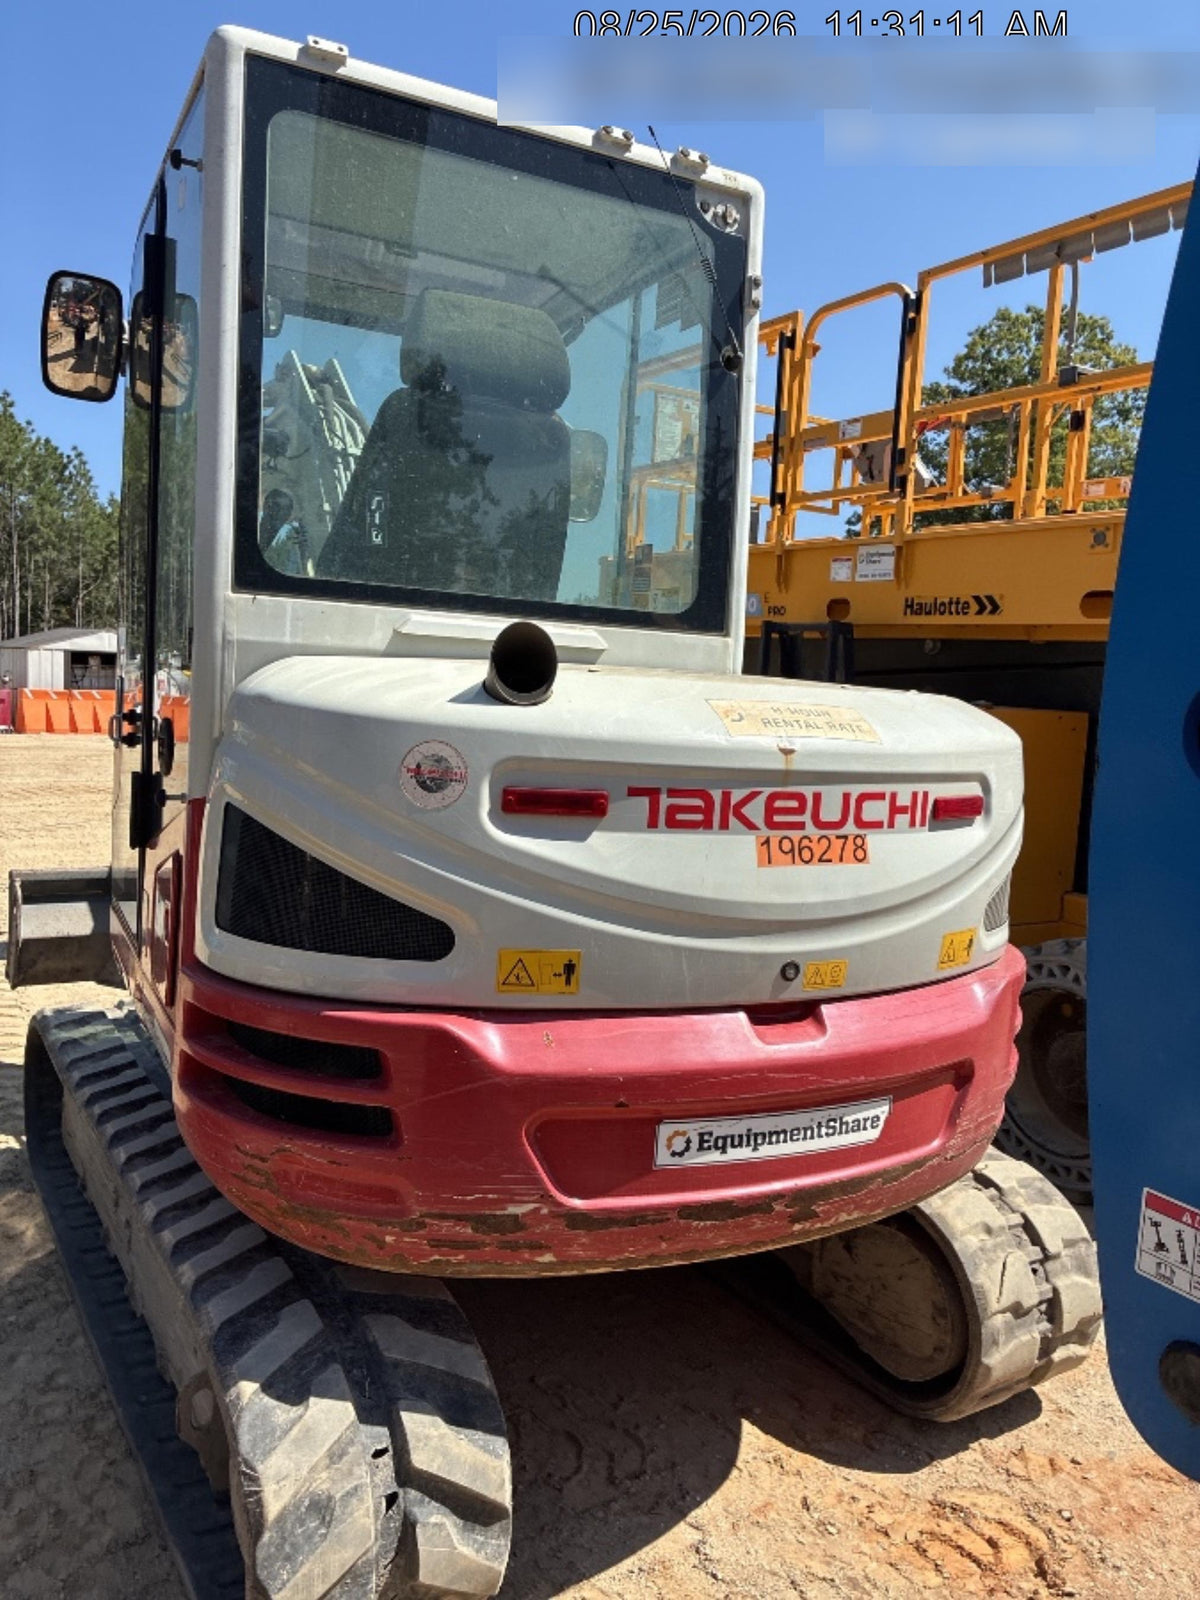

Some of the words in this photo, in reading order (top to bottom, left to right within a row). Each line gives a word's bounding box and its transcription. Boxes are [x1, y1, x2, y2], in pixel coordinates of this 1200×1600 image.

[767, 605, 787, 617] PRO
[903, 596, 971, 616] Haulotte
[760, 717, 824, 730] RENTAL
[759, 834, 868, 866] 196278
[696, 1113, 882, 1155] EquipmentShare
